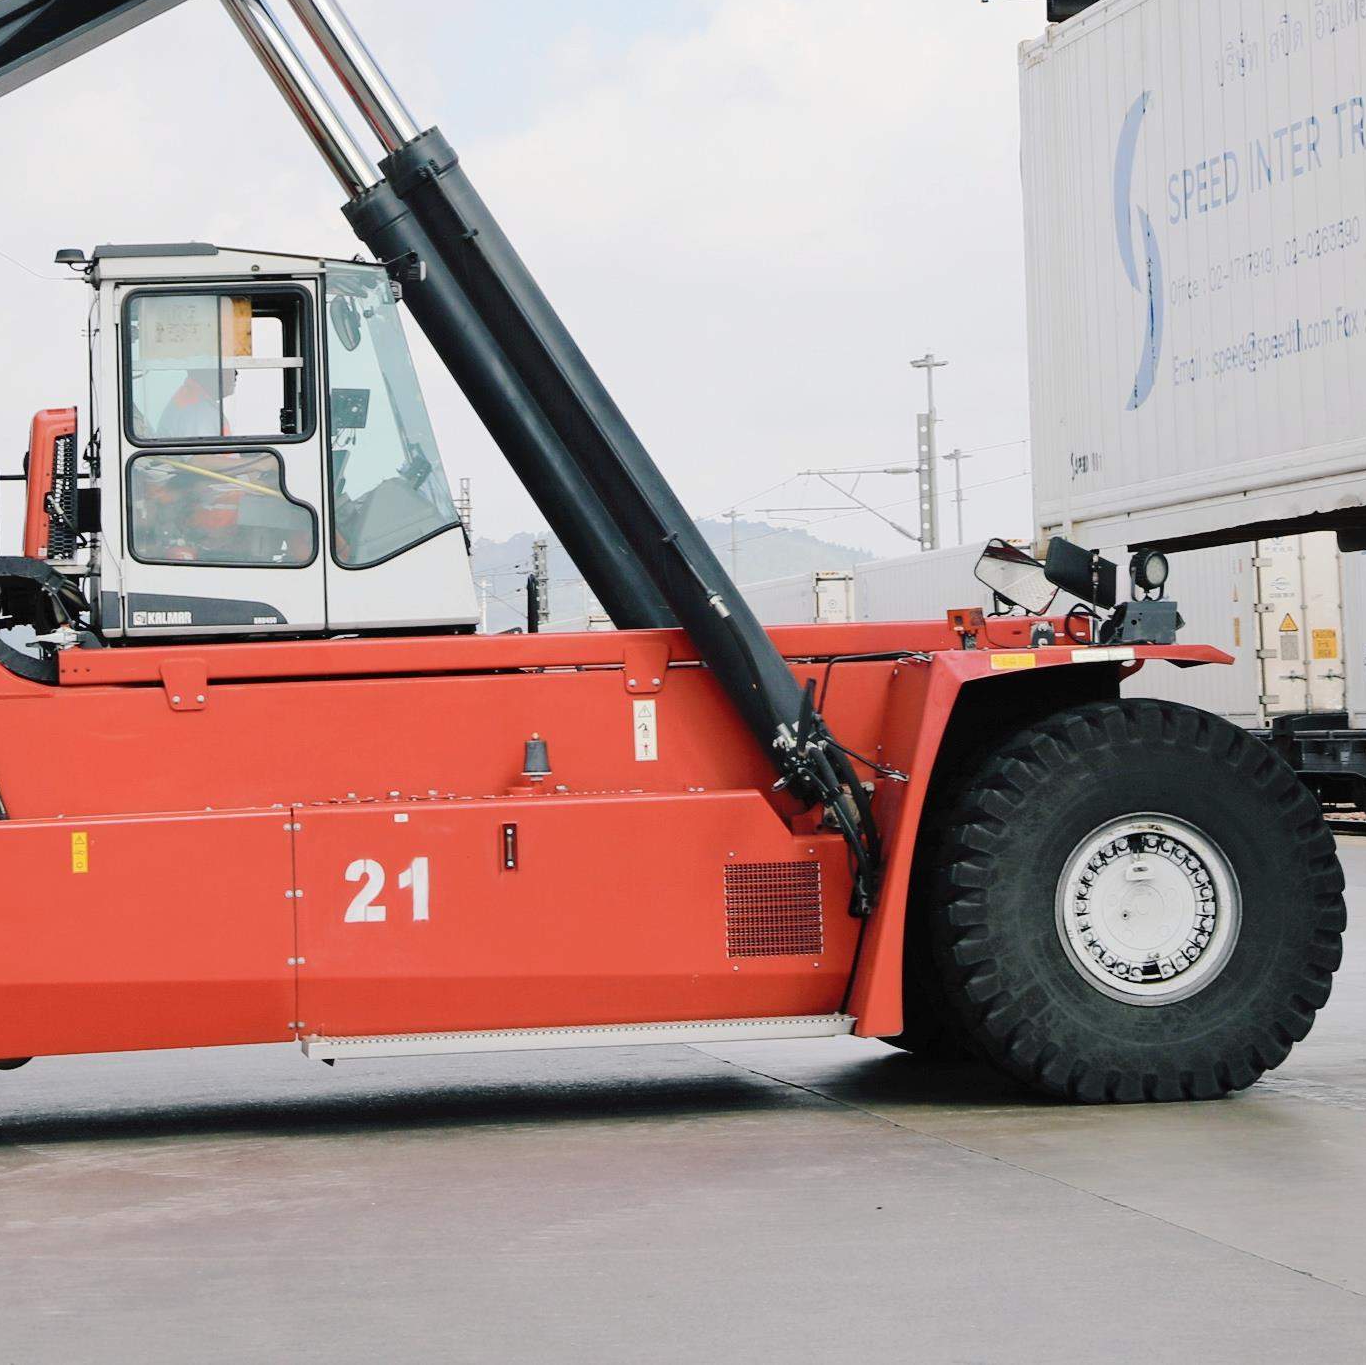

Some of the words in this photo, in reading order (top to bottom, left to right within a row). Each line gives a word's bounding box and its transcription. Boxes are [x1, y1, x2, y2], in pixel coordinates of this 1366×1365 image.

[1168, 150, 1240, 225] SPEED
[1249, 115, 1322, 194] INTER
[147, 611, 192, 625] KALMAR
[344, 855, 430, 923] 21
